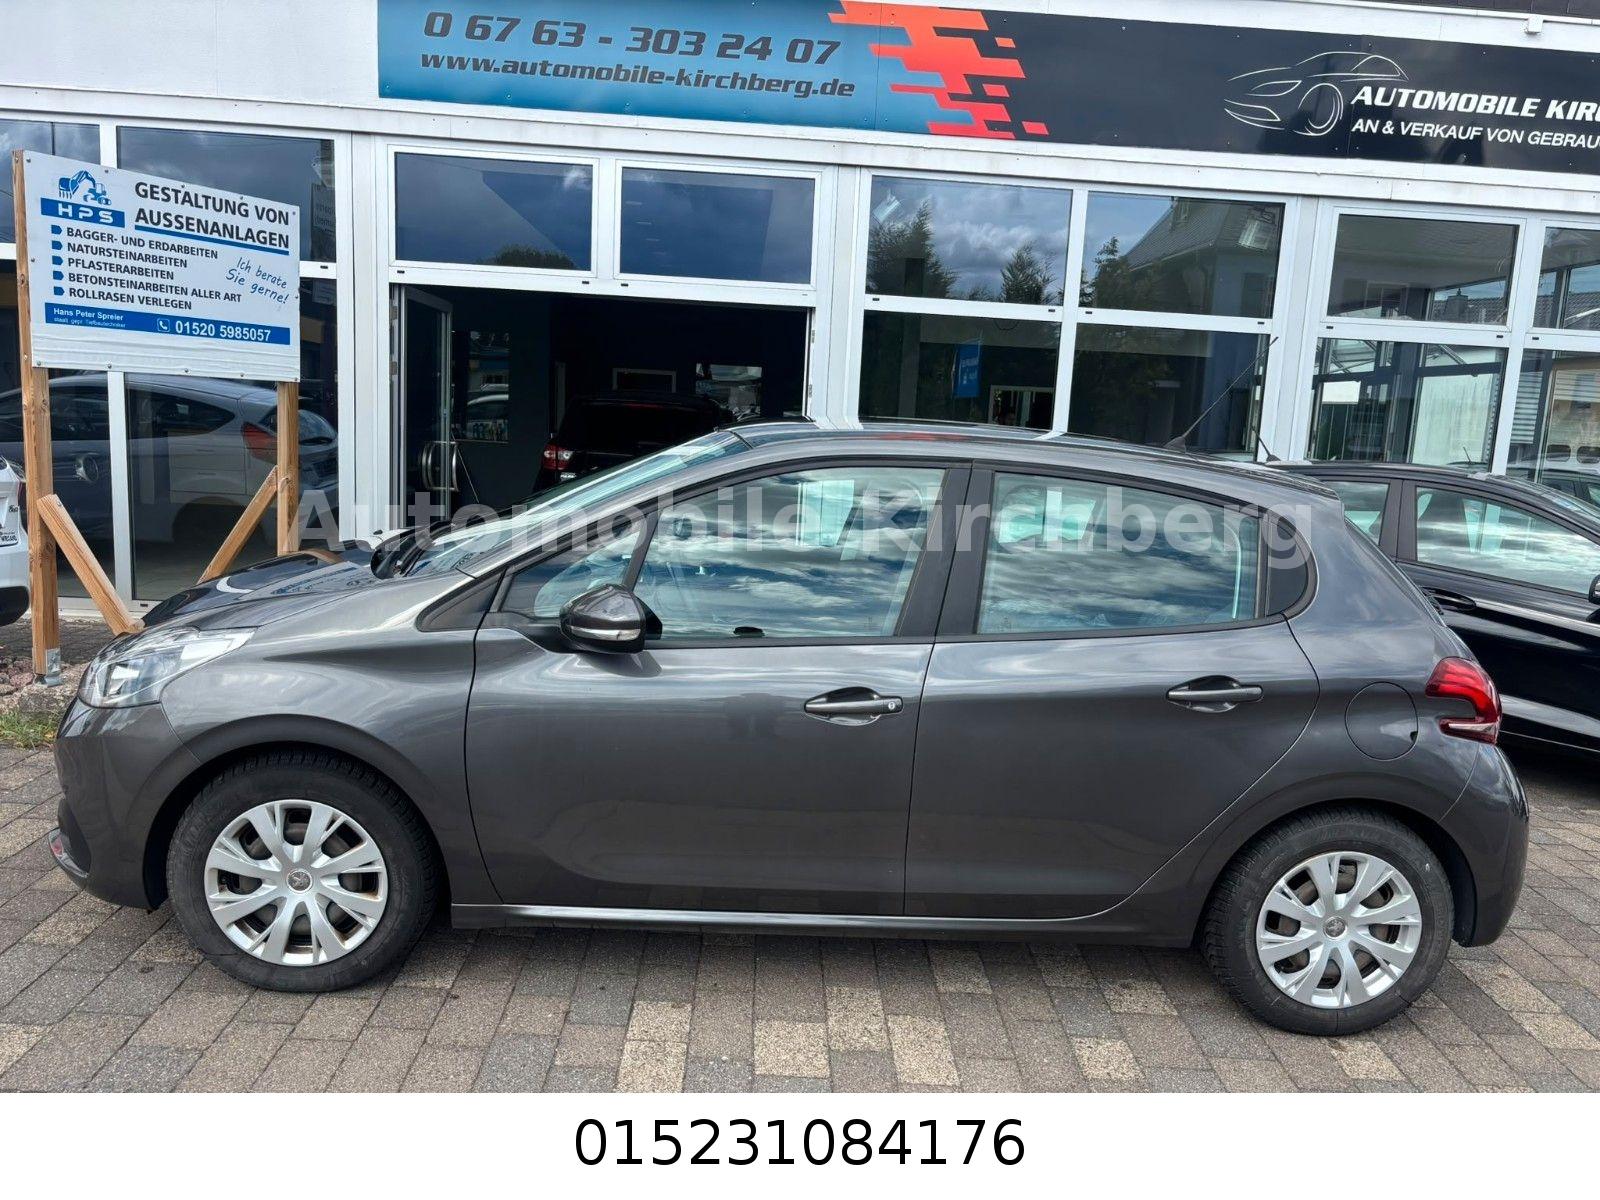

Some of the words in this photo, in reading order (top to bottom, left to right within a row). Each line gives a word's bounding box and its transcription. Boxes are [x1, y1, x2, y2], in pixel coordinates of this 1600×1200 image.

[424, 11, 452, 38] 0
[464, 14, 521, 43] 67
[533, 20, 586, 48] 63
[626, 26, 706, 57] 303
[716, 34, 773, 61] 24
[785, 39, 841, 65] 07
[421, 53, 855, 98] www.automobile-kirchberg.de
[1351, 86, 1541, 118] AUTOMOBILE
[1351, 118, 1380, 133] AN
[1382, 121, 1394, 135] &
[1400, 122, 1483, 141] VERKAUF
[1487, 128, 1524, 143] VON
[134, 181, 250, 218] GESTALTUNG
[254, 207, 289, 226] VON
[67, 227, 118, 244] BAGGER-
[121, 235, 145, 248] UND
[149, 240, 218, 259] ERDARBEITEN
[134, 208, 289, 249] AUSSENANLAGEN
[67, 242, 188, 268] NATURSTEINARBEITEN
[68, 257, 174, 280] PFLASTERARBEITEN
[68, 272, 188, 296] BETONSTEINARBEITEN
[191, 288, 221, 301] ALLER
[223, 292, 242, 303] ART
[226, 269, 245, 285] Sie
[250, 283, 289, 304] gerne!
[237, 257, 251, 273] Ich
[256, 265, 287, 289] berate
[53, 308, 73, 317] Hans
[75, 309, 95, 319] Peter
[69, 287, 135, 304] ROLLRASEN
[138, 295, 192, 310] VERLEGEN
[175, 320, 215, 337] 01520
[219, 323, 271, 342] 5985057
